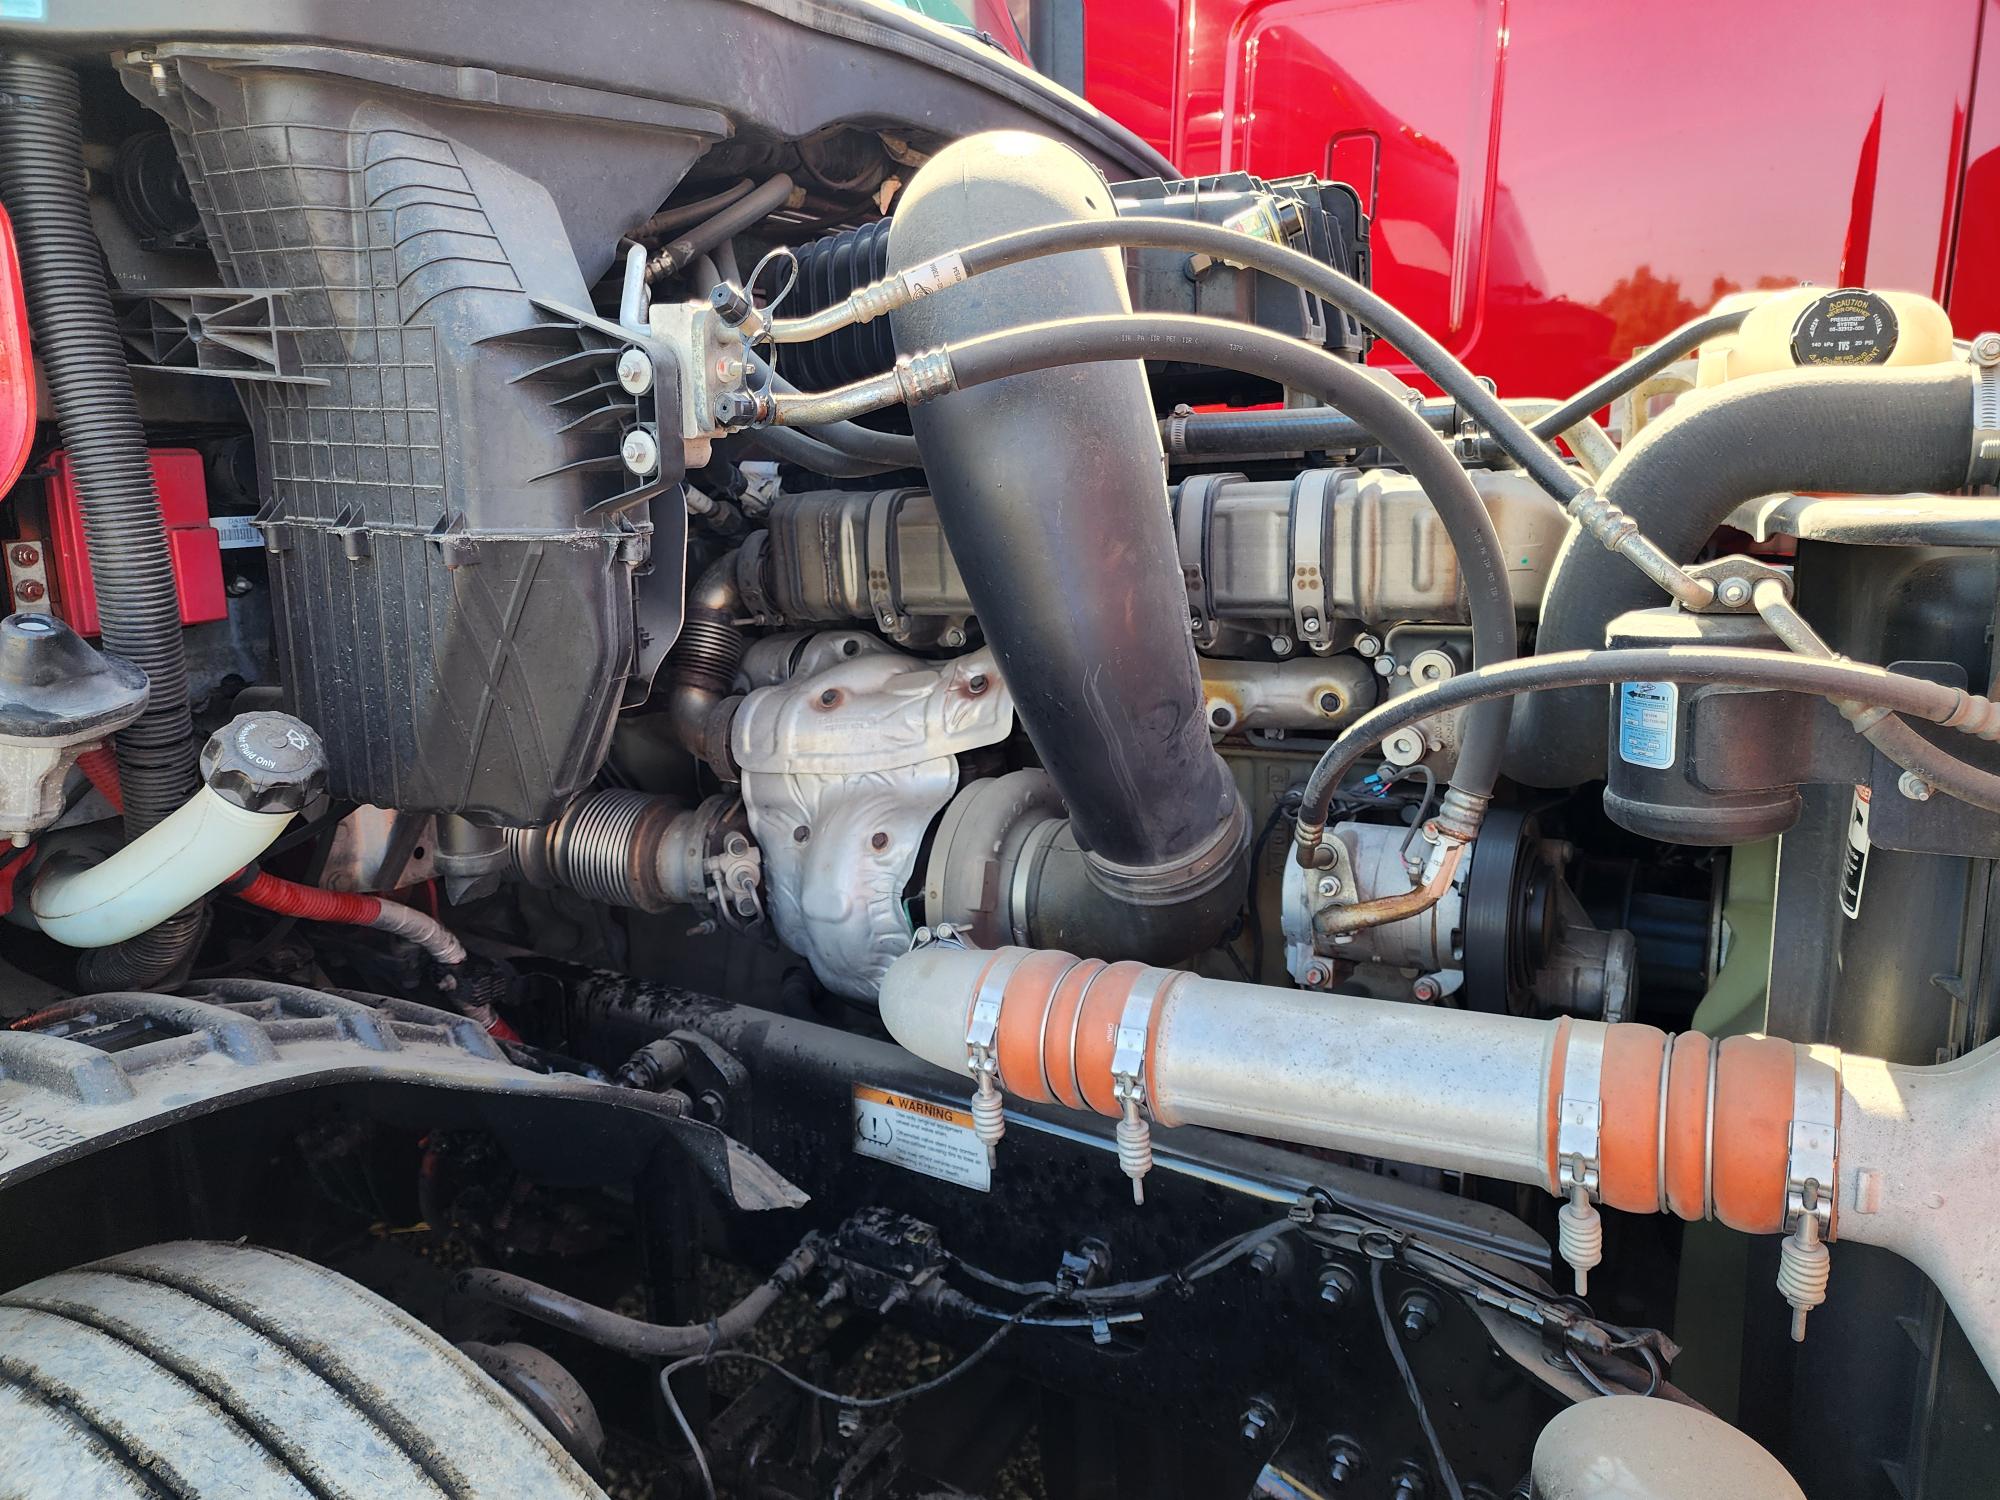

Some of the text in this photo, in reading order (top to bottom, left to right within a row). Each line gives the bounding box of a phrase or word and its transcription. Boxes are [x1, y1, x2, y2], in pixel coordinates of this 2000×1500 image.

[1835, 299, 1869, 309] CAUTION
[1838, 341, 1850, 351] TVS
[239, 723, 276, 769] Washer Fluid Only
[898, 1098, 953, 1122] WARNING
